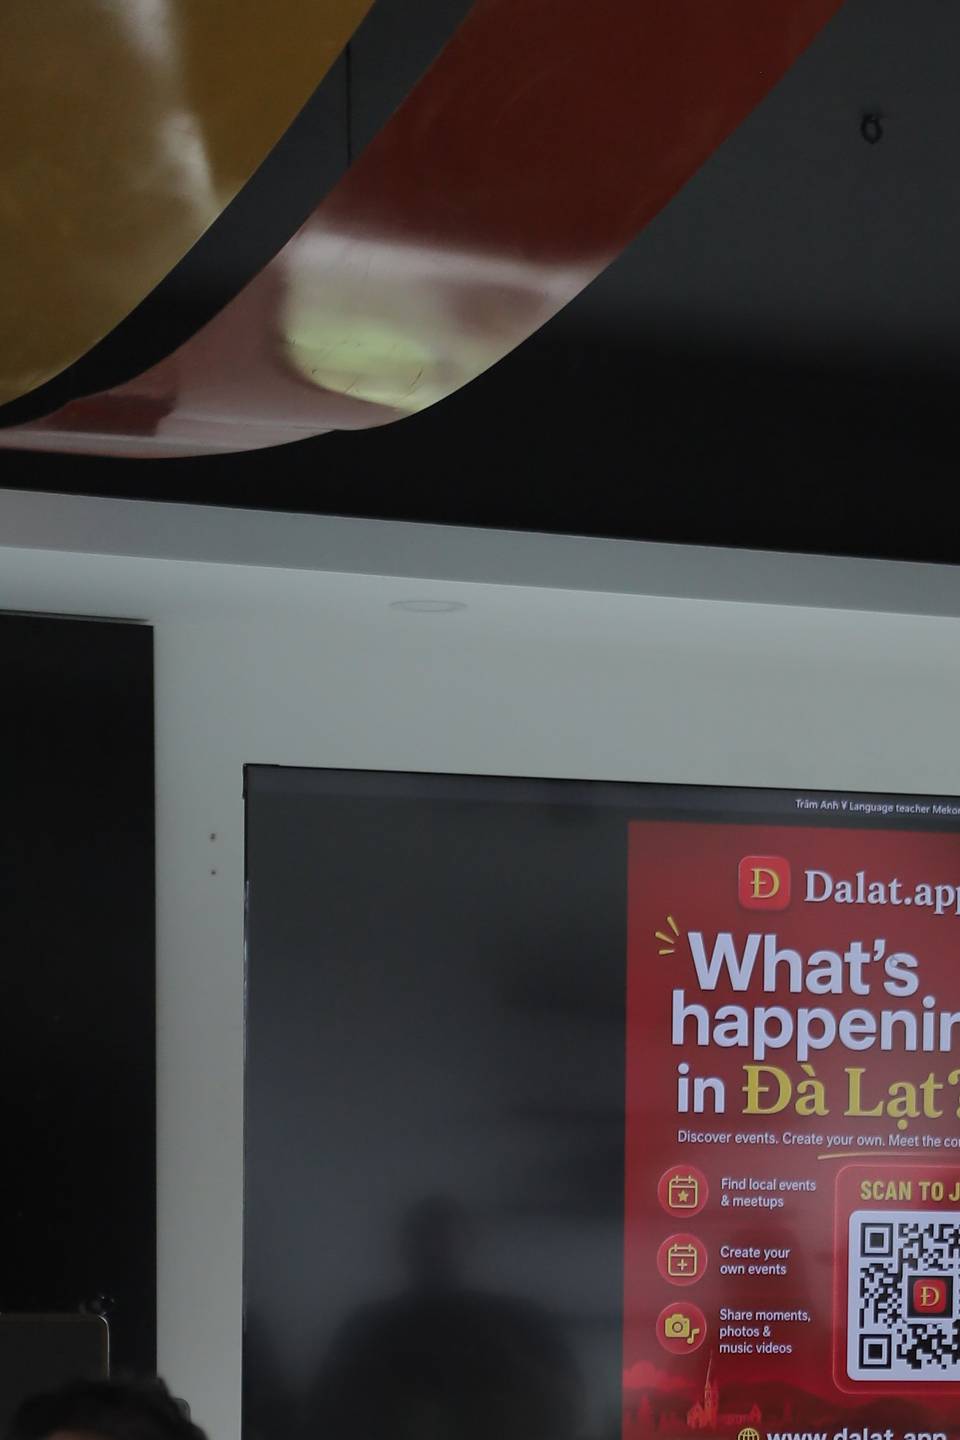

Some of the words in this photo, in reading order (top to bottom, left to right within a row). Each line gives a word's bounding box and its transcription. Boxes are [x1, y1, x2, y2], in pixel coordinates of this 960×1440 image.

[820, 801, 838, 809] Anh
[849, 802, 893, 814] Language
[896, 804, 929, 813] teacher
[688, 932, 919, 997] What’s
[677, 1063, 725, 1113] in
[742, 1064, 829, 1116] Đà
[678, 1130, 731, 1144] Discover
[735, 1133, 778, 1144] events.
[782, 1133, 823, 1146] Create
[826, 1136, 853, 1148] your
[857, 1136, 885, 1147] own.
[889, 1135, 918, 1147] Meet
[922, 1136, 941, 1148] the
[721, 1178, 746, 1192] Find
[749, 1178, 776, 1192] local
[779, 1180, 815, 1192] events
[860, 1182, 912, 1201] SCAN
[919, 1182, 943, 1201] TO
[721, 1195, 729, 1207] &
[733, 1195, 784, 1210] meetups
[721, 1246, 760, 1259] Create
[763, 1248, 790, 1262] your
[721, 1265, 744, 1275] own
[748, 1264, 786, 1275] events
[720, 1310, 751, 1322] Share
[756, 1310, 811, 1323] moments,
[720, 1326, 759, 1339] photos
[762, 1326, 770, 1337] &
[720, 1342, 752, 1354] music
[756, 1342, 792, 1354] videos
